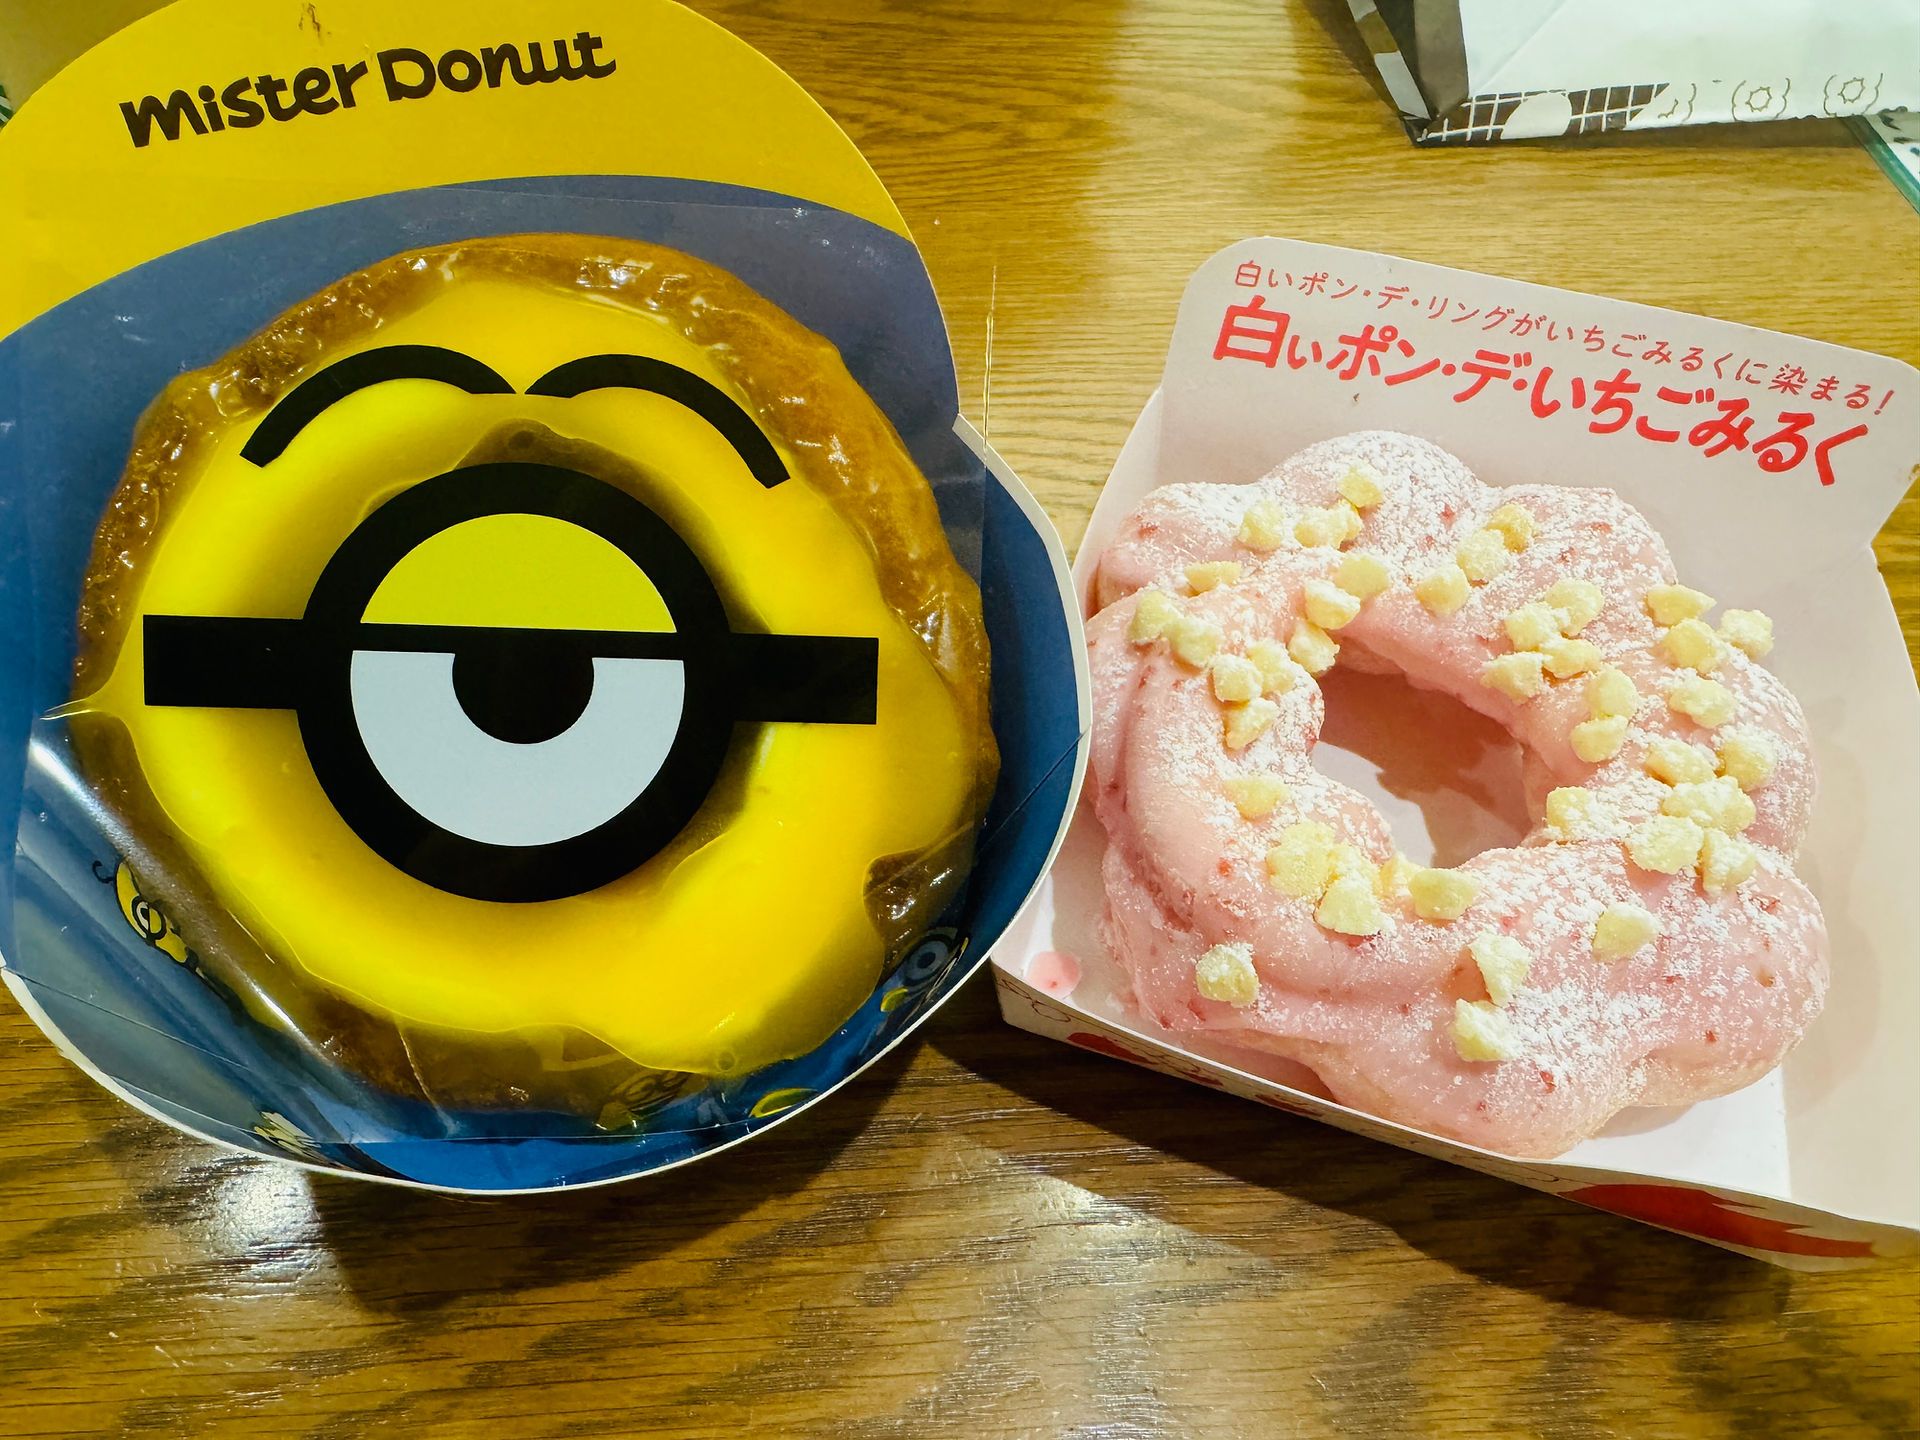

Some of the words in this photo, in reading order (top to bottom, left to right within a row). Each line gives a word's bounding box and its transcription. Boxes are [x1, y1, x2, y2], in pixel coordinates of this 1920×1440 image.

[118, 60, 368, 148] Mister
[376, 31, 617, 102] Donut
[1211, 293, 1870, 487] 白いポン・デ・いちごみるく
